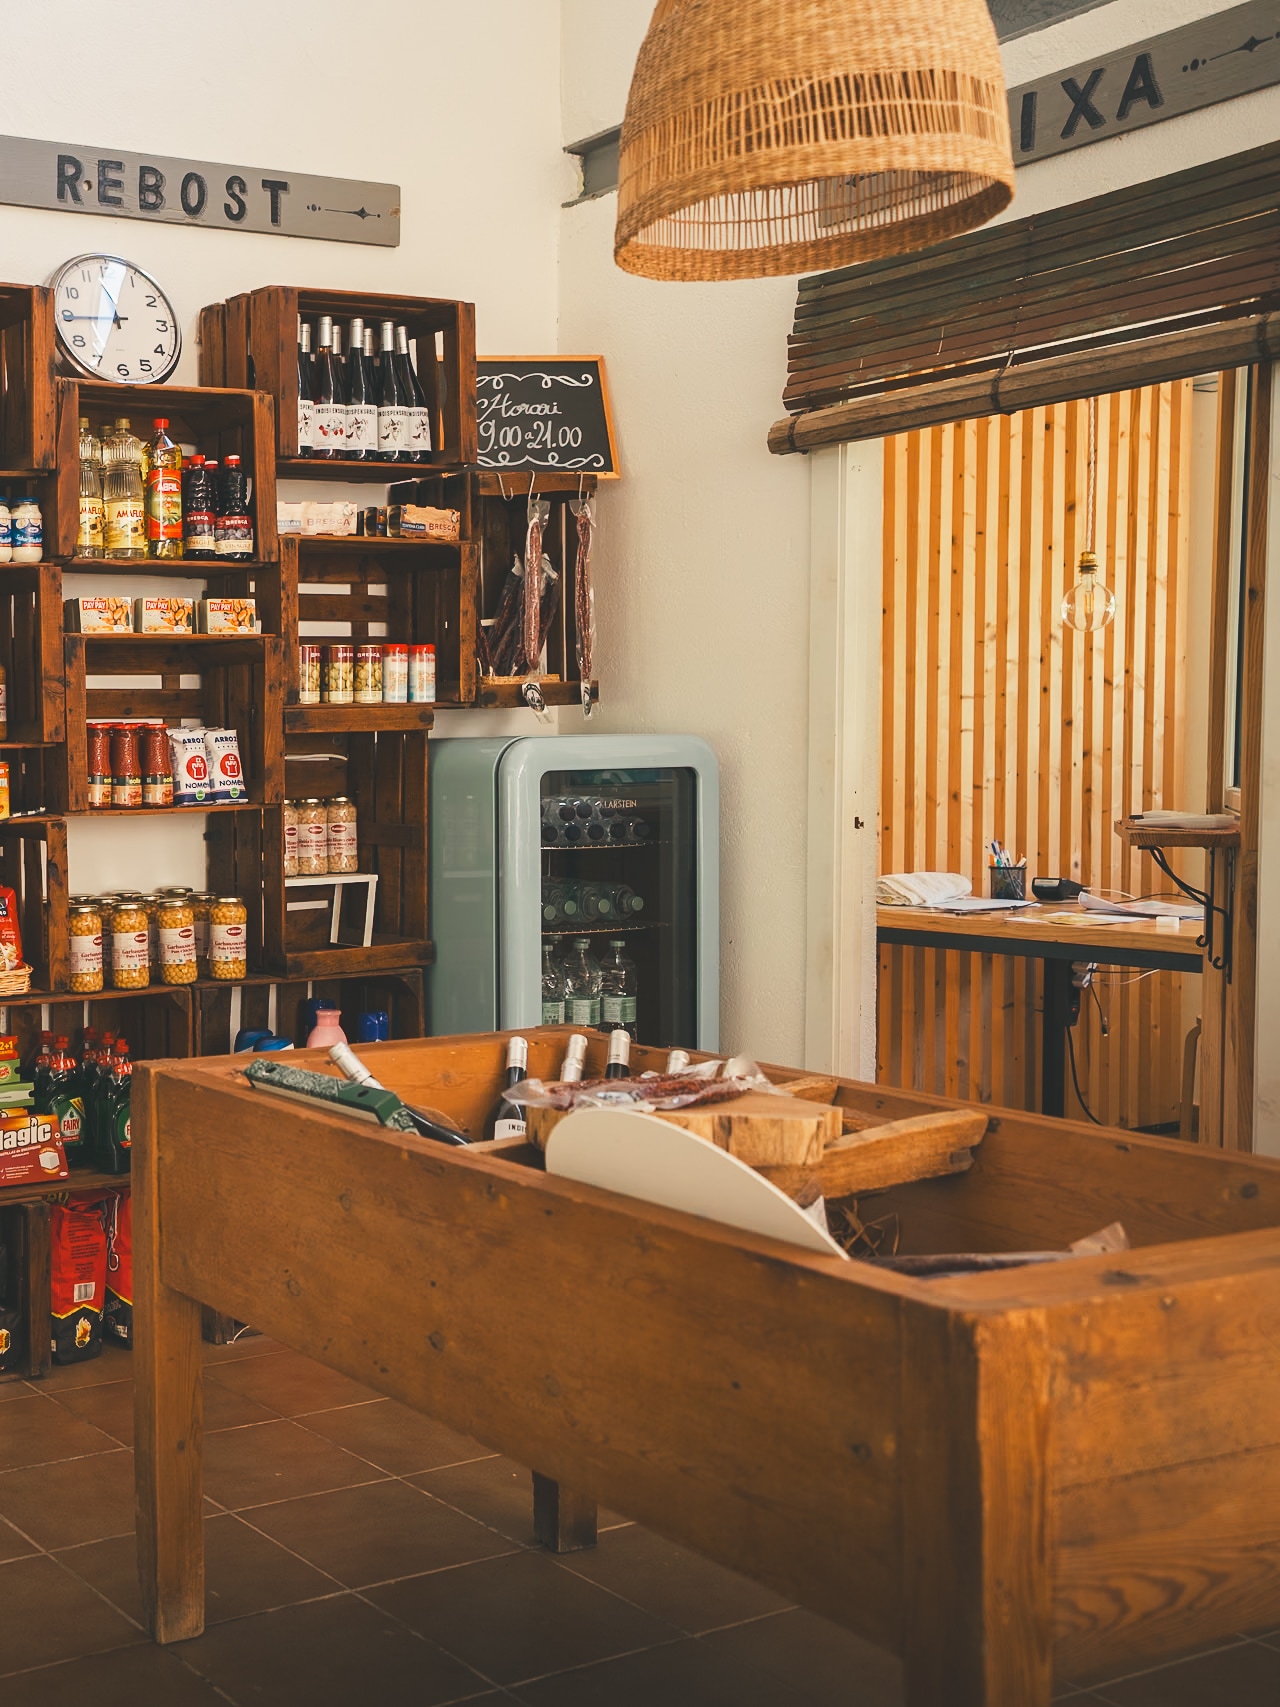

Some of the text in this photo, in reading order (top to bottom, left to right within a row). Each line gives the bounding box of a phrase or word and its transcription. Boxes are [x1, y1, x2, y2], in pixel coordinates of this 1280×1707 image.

[1020, 52, 1165, 152] IXA
[56, 153, 290, 227] REBOST
[82, 269, 91, 283] 11
[130, 275, 134, 288] 1
[65, 286, 79, 299] 10
[144, 295, 157, 308] 2
[155, 319, 168, 332] 3
[72, 335, 86, 348] 8
[153, 344, 166, 356] 4
[92, 354, 103, 367] 7
[139, 359, 153, 372] 5
[117, 363, 130, 376] 6
[477, 393, 562, 422] Horari
[477, 420, 582, 453] 9.00 a 21.00
[157, 482, 180, 492] ABRIL
[307, 518, 351, 527] BRESCA
[429, 522, 457, 533] BRESCA
[83, 601, 106, 610] PAY PAY
[147, 602, 168, 610] PAY PAY
[210, 602, 232, 611] PAY PAY
[182, 737, 205, 745] ARROZ
[599, 799, 637, 809] KLARSTEIN
[63, 1118, 80, 1132] FAIRY
